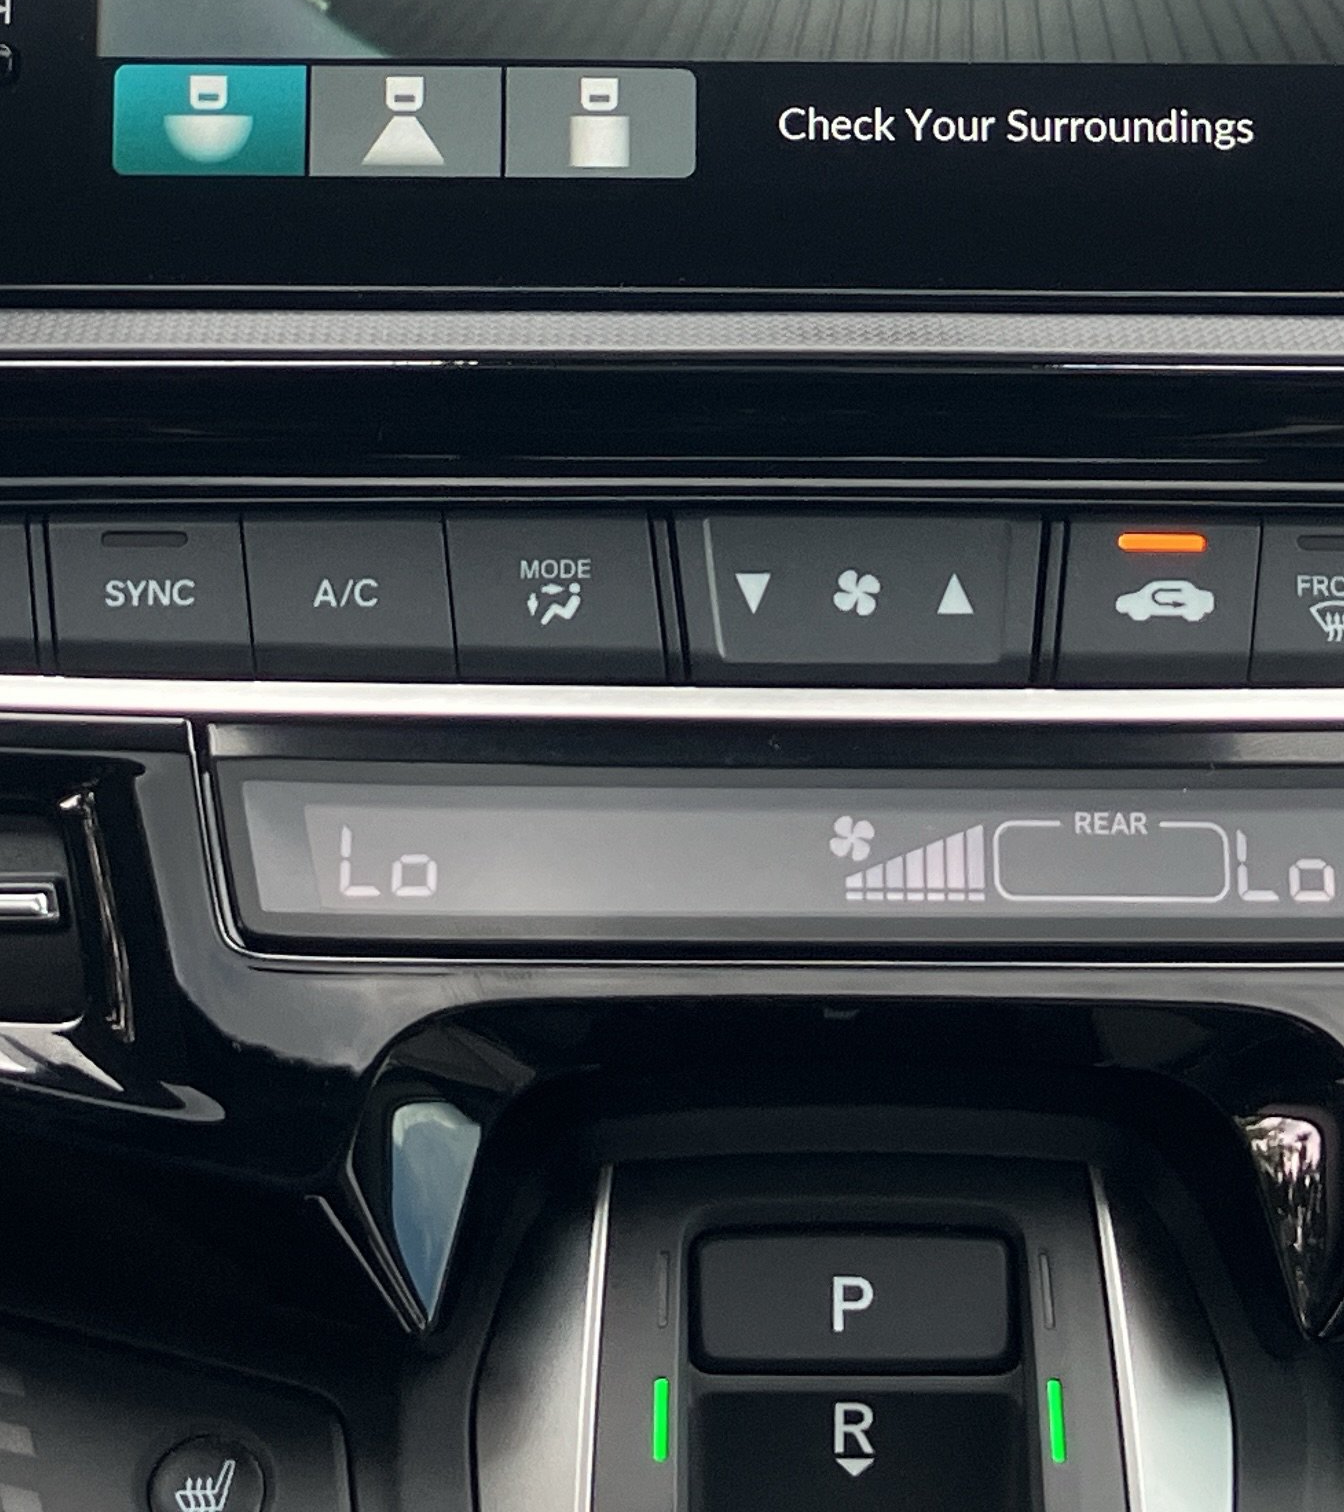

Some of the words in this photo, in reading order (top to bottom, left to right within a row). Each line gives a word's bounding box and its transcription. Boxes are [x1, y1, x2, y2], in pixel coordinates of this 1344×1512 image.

[777, 106, 897, 142] Check
[905, 107, 997, 143] Your
[1006, 107, 1256, 152] Surroundings
[519, 558, 592, 580] MODE
[104, 579, 196, 608] SYNC
[312, 578, 379, 608] A/C
[1073, 810, 1149, 836] REAR
[338, 824, 439, 899] Lo
[1234, 829, 1337, 904] Lo
[831, 1275, 875, 1333] P
[833, 1401, 875, 1455] R
